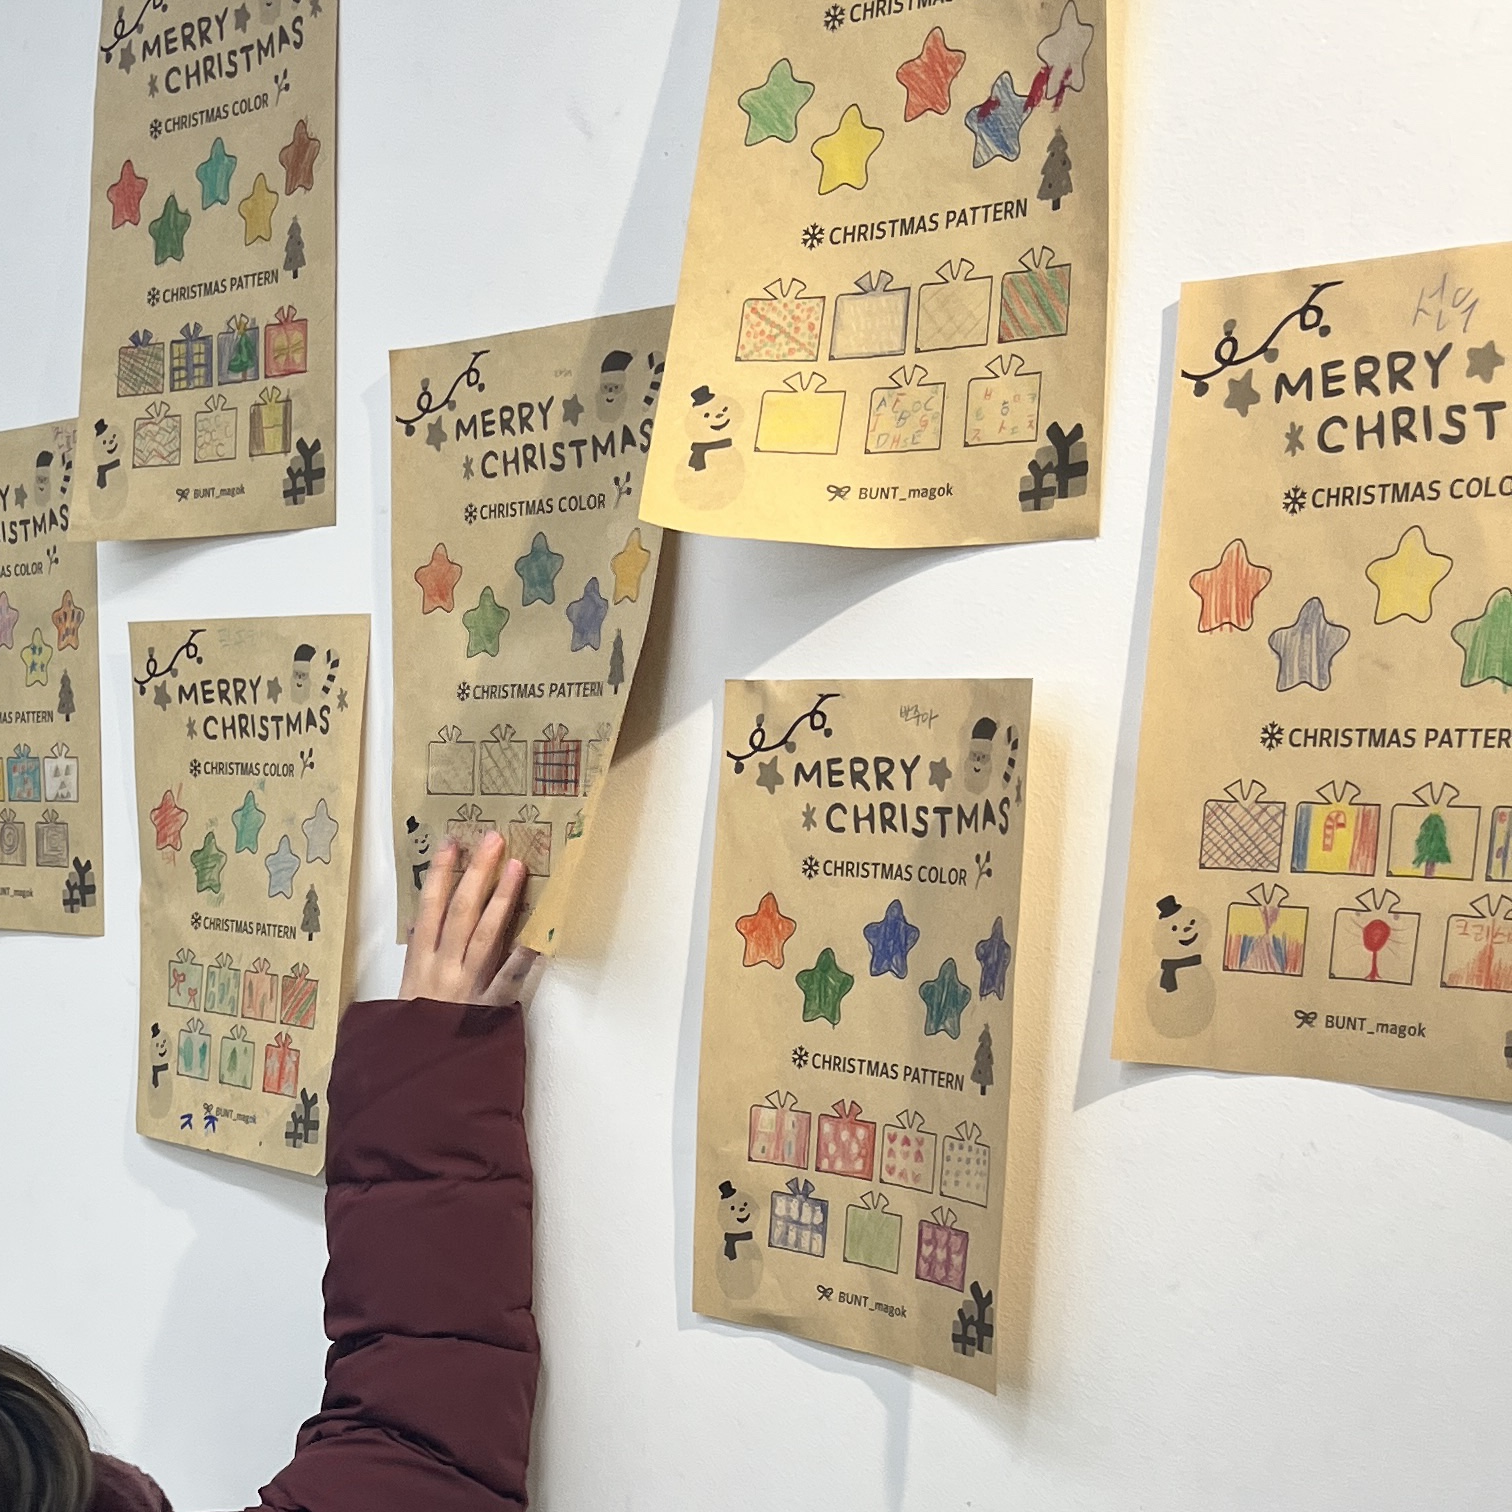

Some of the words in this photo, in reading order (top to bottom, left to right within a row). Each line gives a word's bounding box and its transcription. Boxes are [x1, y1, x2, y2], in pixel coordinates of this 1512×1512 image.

[142, 6, 229, 63] MERRY
[165, 15, 304, 94] CHRISTMAS
[164, 105, 229, 134] CHRISTMAS
[232, 92, 269, 117] COLOR
[829, 211, 939, 246] CHRISTMAS
[945, 199, 1028, 232] PATTERN
[162, 277, 227, 304] CHRISTMAS
[229, 268, 279, 292] PATTERN
[1275, 342, 1453, 404] MERRY
[456, 395, 555, 442] MERRY
[481, 418, 654, 479] CHRISTMAS
[480, 497, 554, 521] CHRISTMAS
[558, 493, 606, 513] COLOR
[858, 484, 954, 501] BUNT_magok
[1312, 480, 1441, 509] CHRISTMAS
[14, 561, 44, 577] COLOR
[178, 675, 262, 706] MERRY
[472, 682, 545, 700] CHRISTMAS
[548, 681, 604, 698] PATTERN
[15, 710, 54, 724] PATTERN
[203, 704, 331, 742] CHRISTMAS
[1288, 728, 1416, 749] CHRISTMAS
[203, 761, 261, 777] CHRISTMAS
[262, 762, 295, 778] COLOR
[794, 755, 921, 791] MERRY
[826, 797, 1010, 838] CHRISTMAS
[823, 859, 912, 882] CHRISTMAS
[918, 865, 967, 886] COLOR
[203, 916, 254, 936] CHRISTMAS
[256, 922, 297, 940] PATTERN
[1325, 1014, 1426, 1038] BUNT_magok
[811, 1053, 899, 1080] CHRISTMAS
[903, 1066, 964, 1092] PATTERN
[838, 1291, 907, 1319] BUNT_magok
